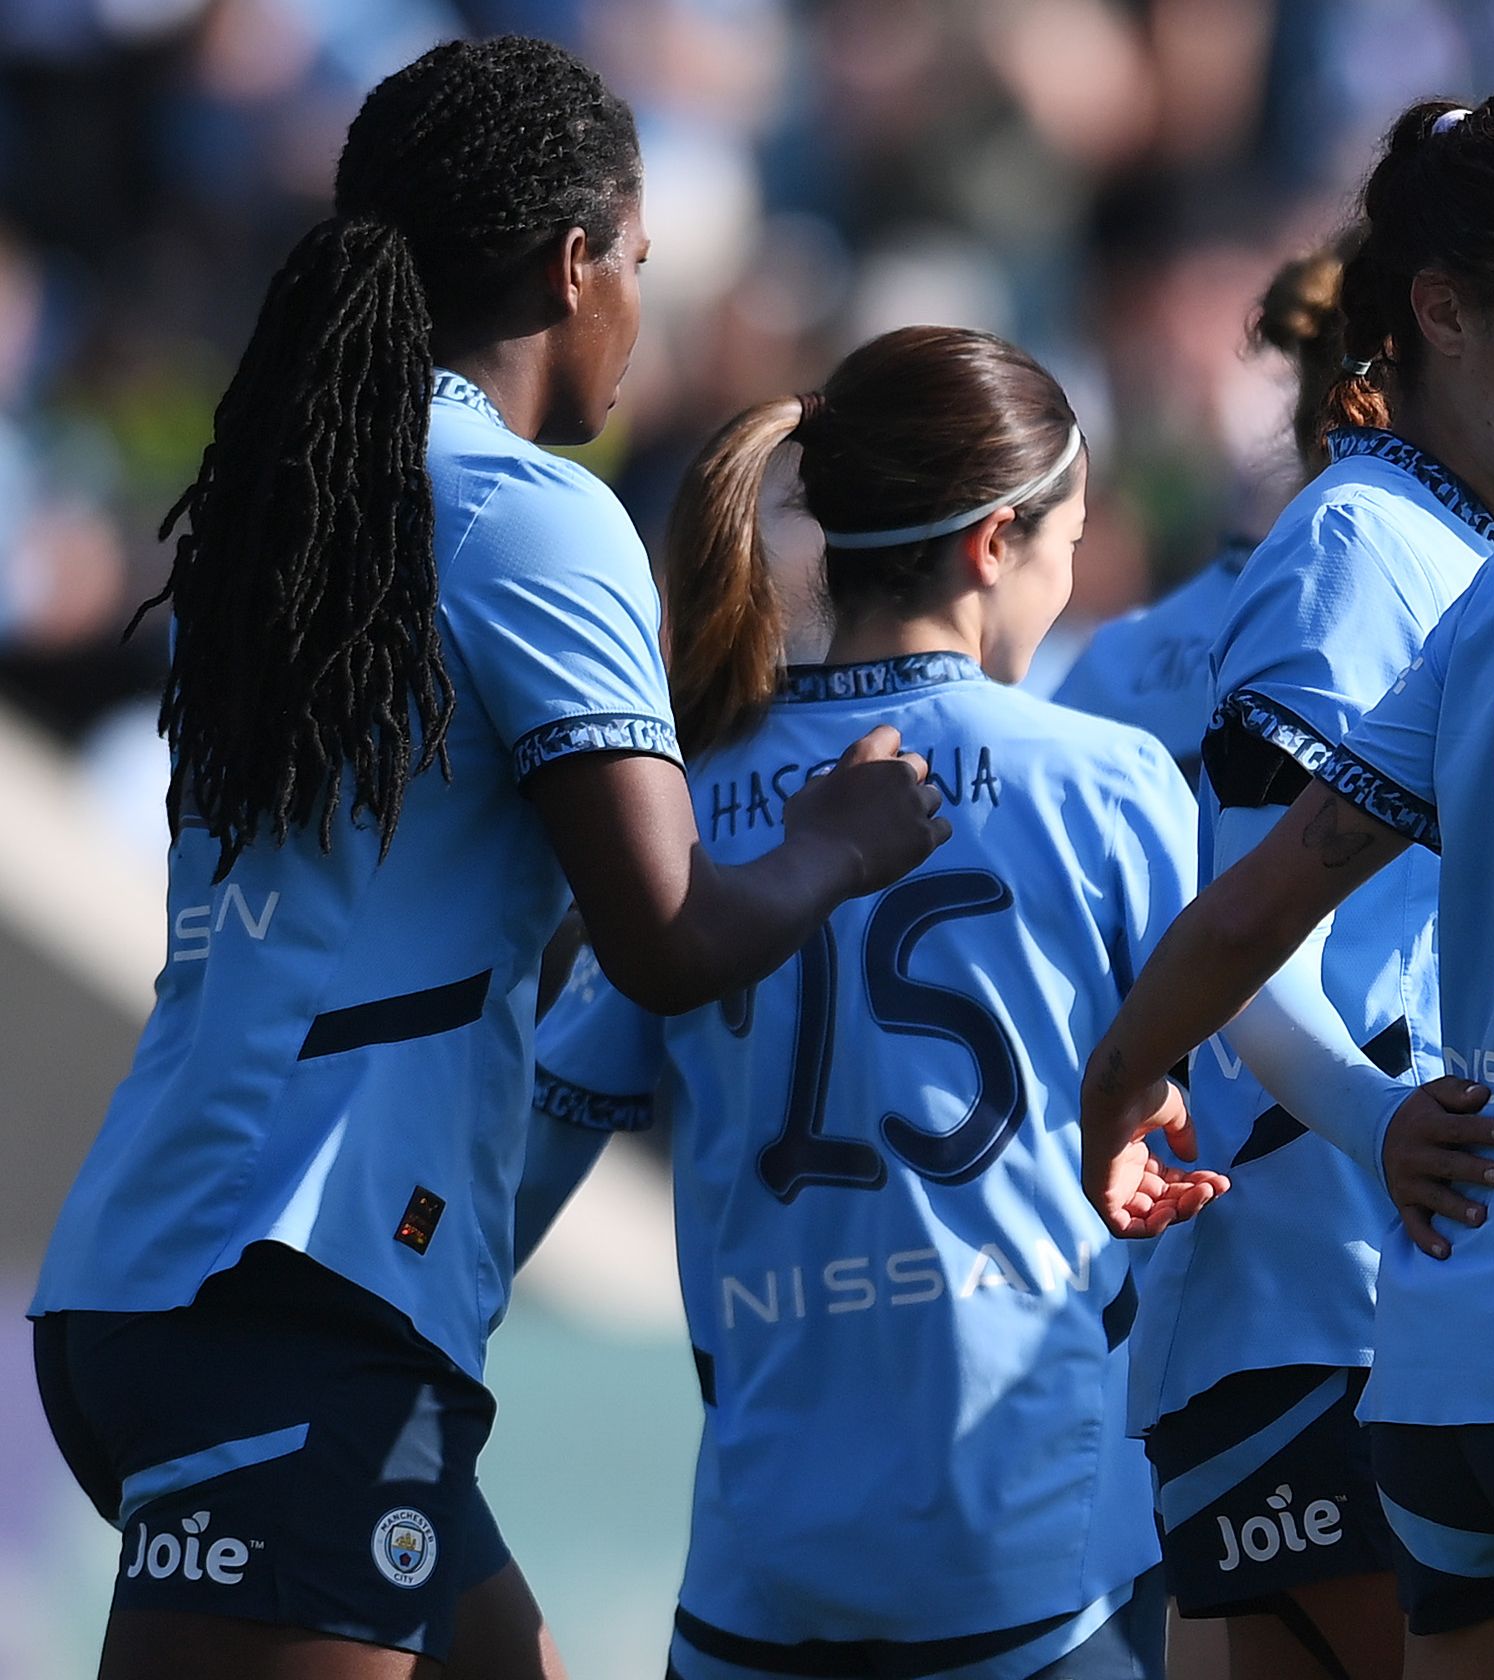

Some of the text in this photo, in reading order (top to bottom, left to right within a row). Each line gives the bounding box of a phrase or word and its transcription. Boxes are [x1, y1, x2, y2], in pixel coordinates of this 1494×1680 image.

[722, 1238, 1091, 1329] NISSAN
[127, 1511, 248, 1585] Joie
[381, 1511, 434, 1543] MANCHESTER
[1216, 1484, 1342, 1571] Joie
[394, 1573, 414, 1584] CITY
